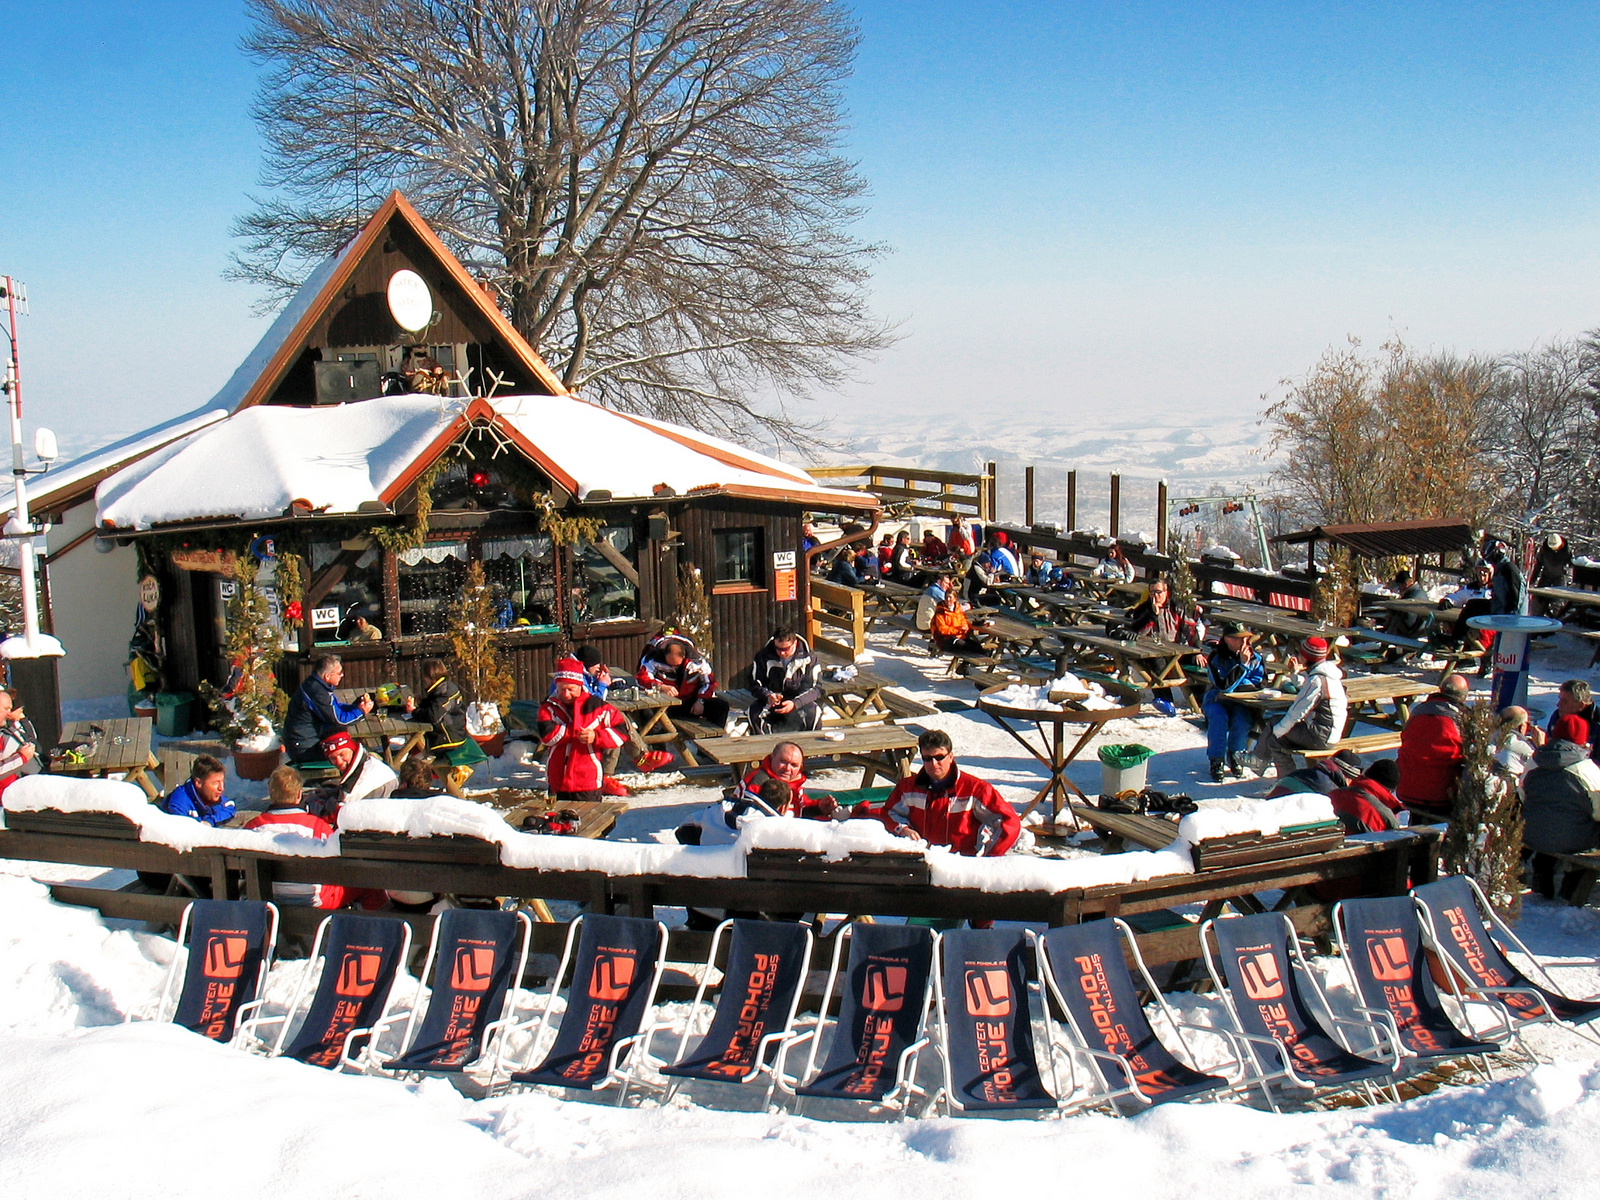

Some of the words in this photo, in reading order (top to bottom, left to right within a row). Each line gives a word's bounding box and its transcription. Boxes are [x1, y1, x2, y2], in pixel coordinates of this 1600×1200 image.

[777, 552, 792, 561] WC
[315, 608, 336, 619] WC
[1495, 653, 1516, 665] Bull
[444, 994, 464, 1041] CENTER
[578, 1003, 601, 1053] CENTER
[976, 1021, 991, 1072] CENTER
